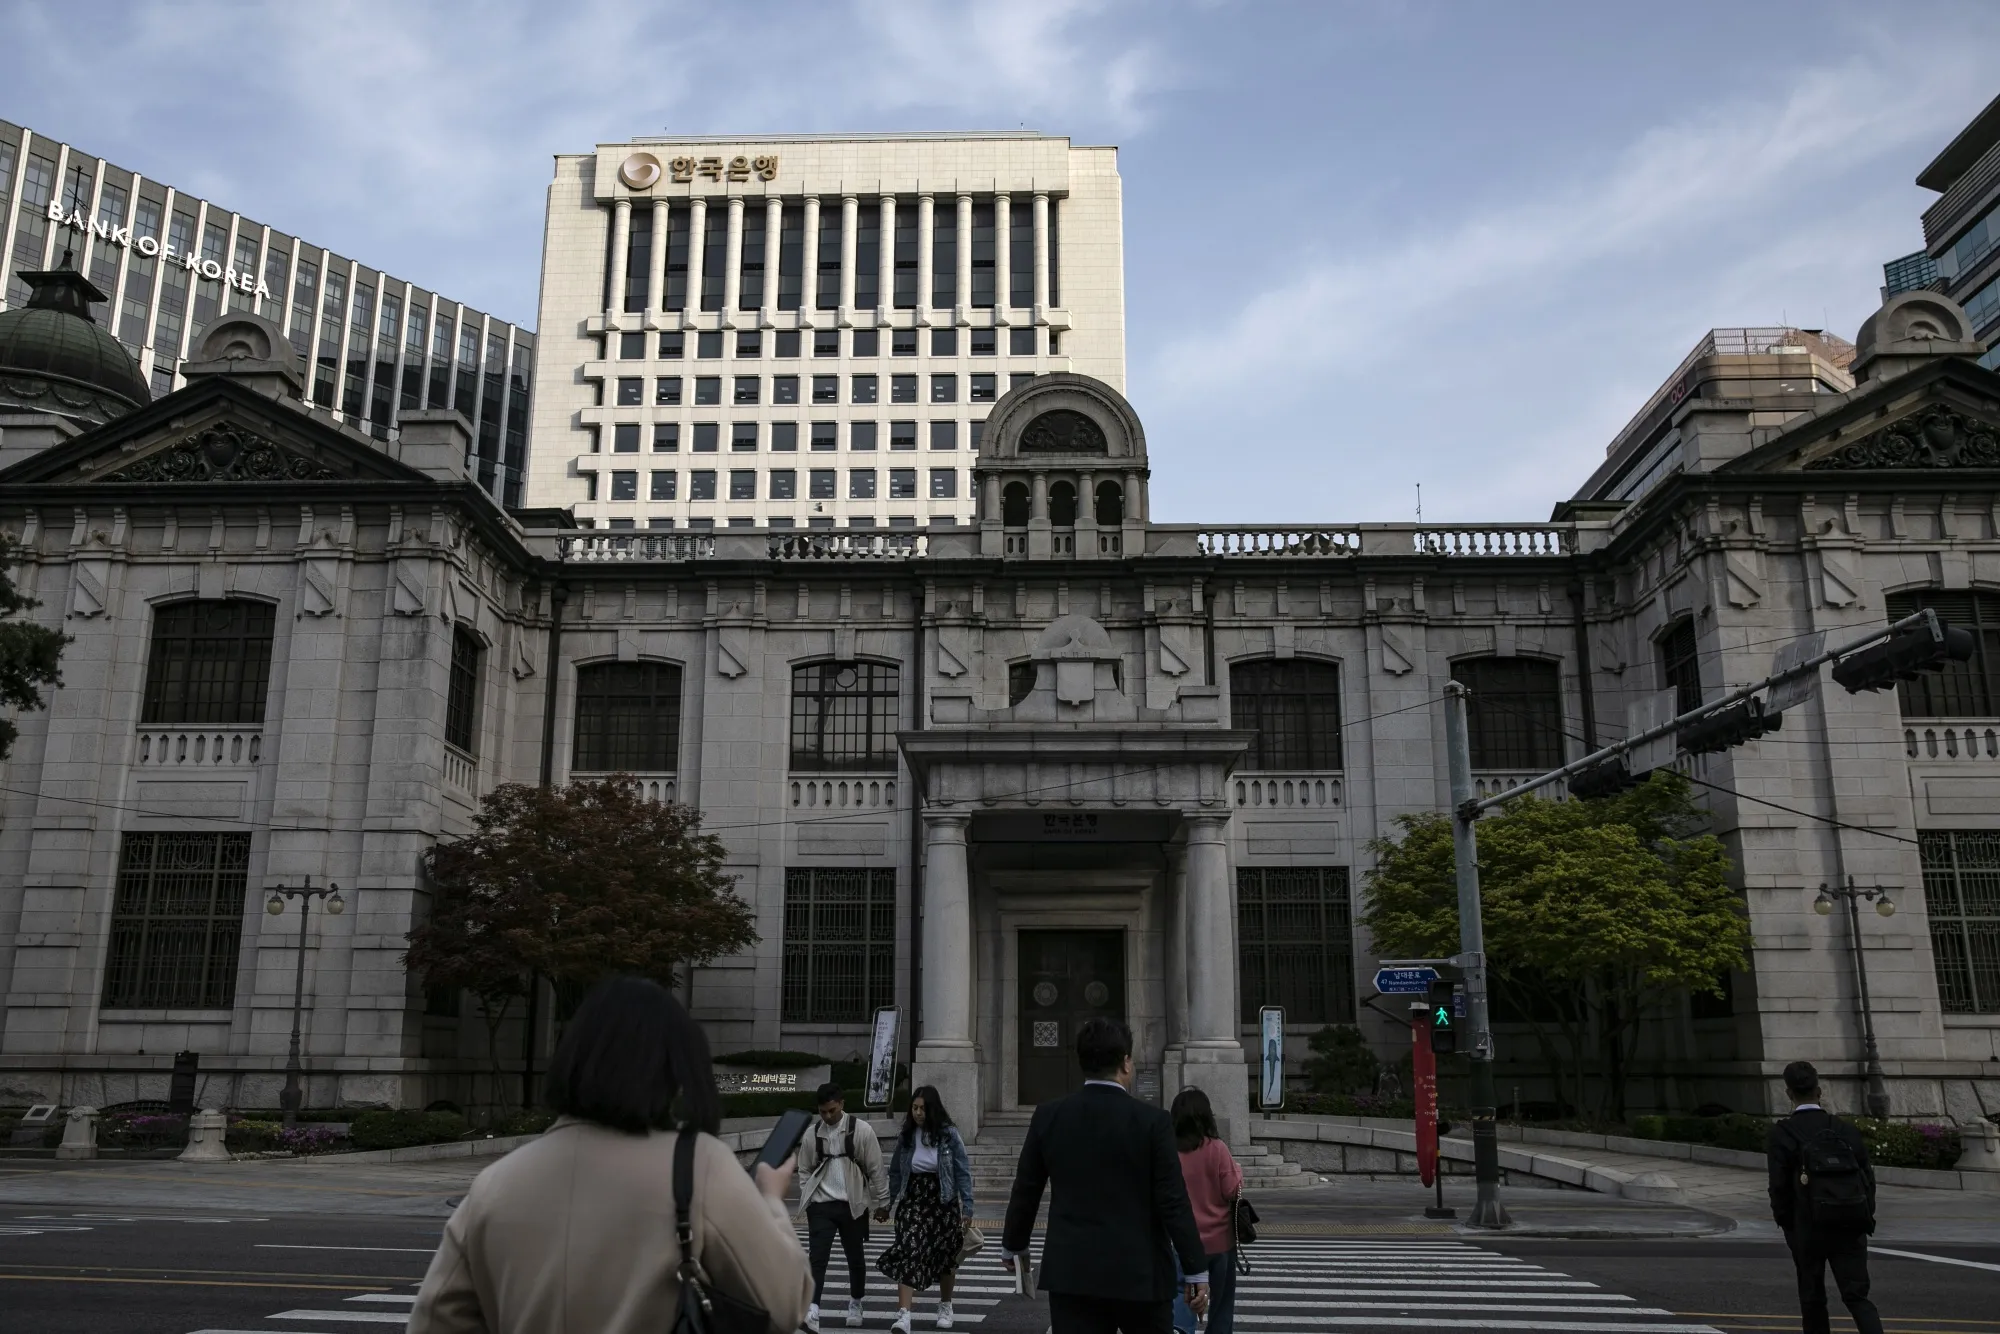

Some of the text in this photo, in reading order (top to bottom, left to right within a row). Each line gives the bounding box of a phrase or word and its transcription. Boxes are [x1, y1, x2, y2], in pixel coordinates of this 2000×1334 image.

[672, 155, 779, 182] 한국은행
[47, 199, 271, 299] BANK OF KOREA
[1393, 971, 1421, 980] 남대문로
[751, 1073, 797, 1085] 화폐박물관
